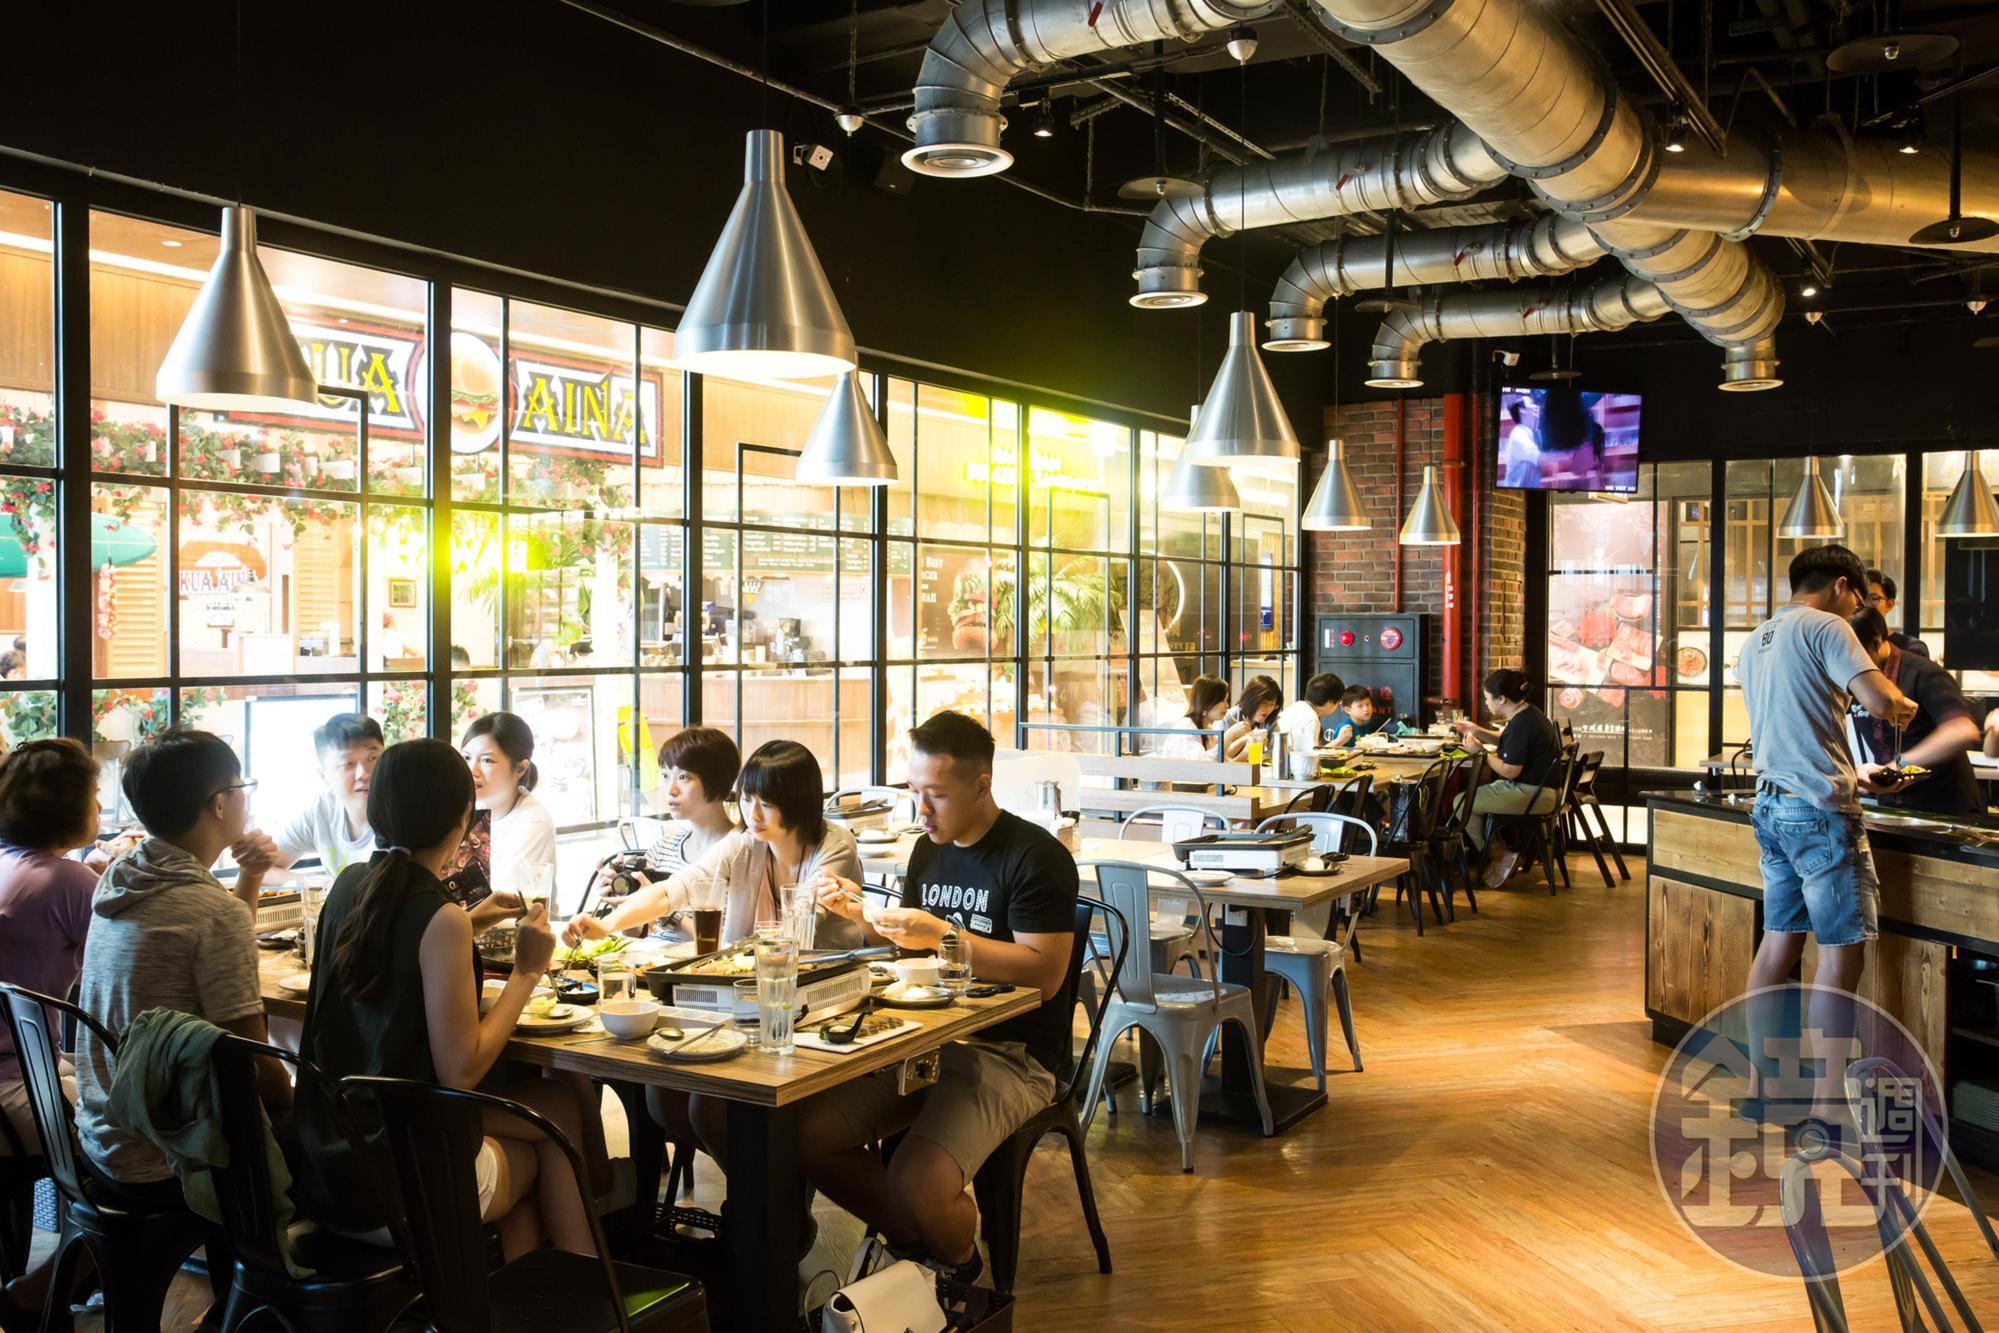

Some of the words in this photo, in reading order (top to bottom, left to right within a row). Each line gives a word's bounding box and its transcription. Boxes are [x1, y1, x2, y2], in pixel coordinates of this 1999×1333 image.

[311, 342, 400, 413] UA
[523, 376, 646, 444] AINA
[922, 884, 989, 912] LONDON
